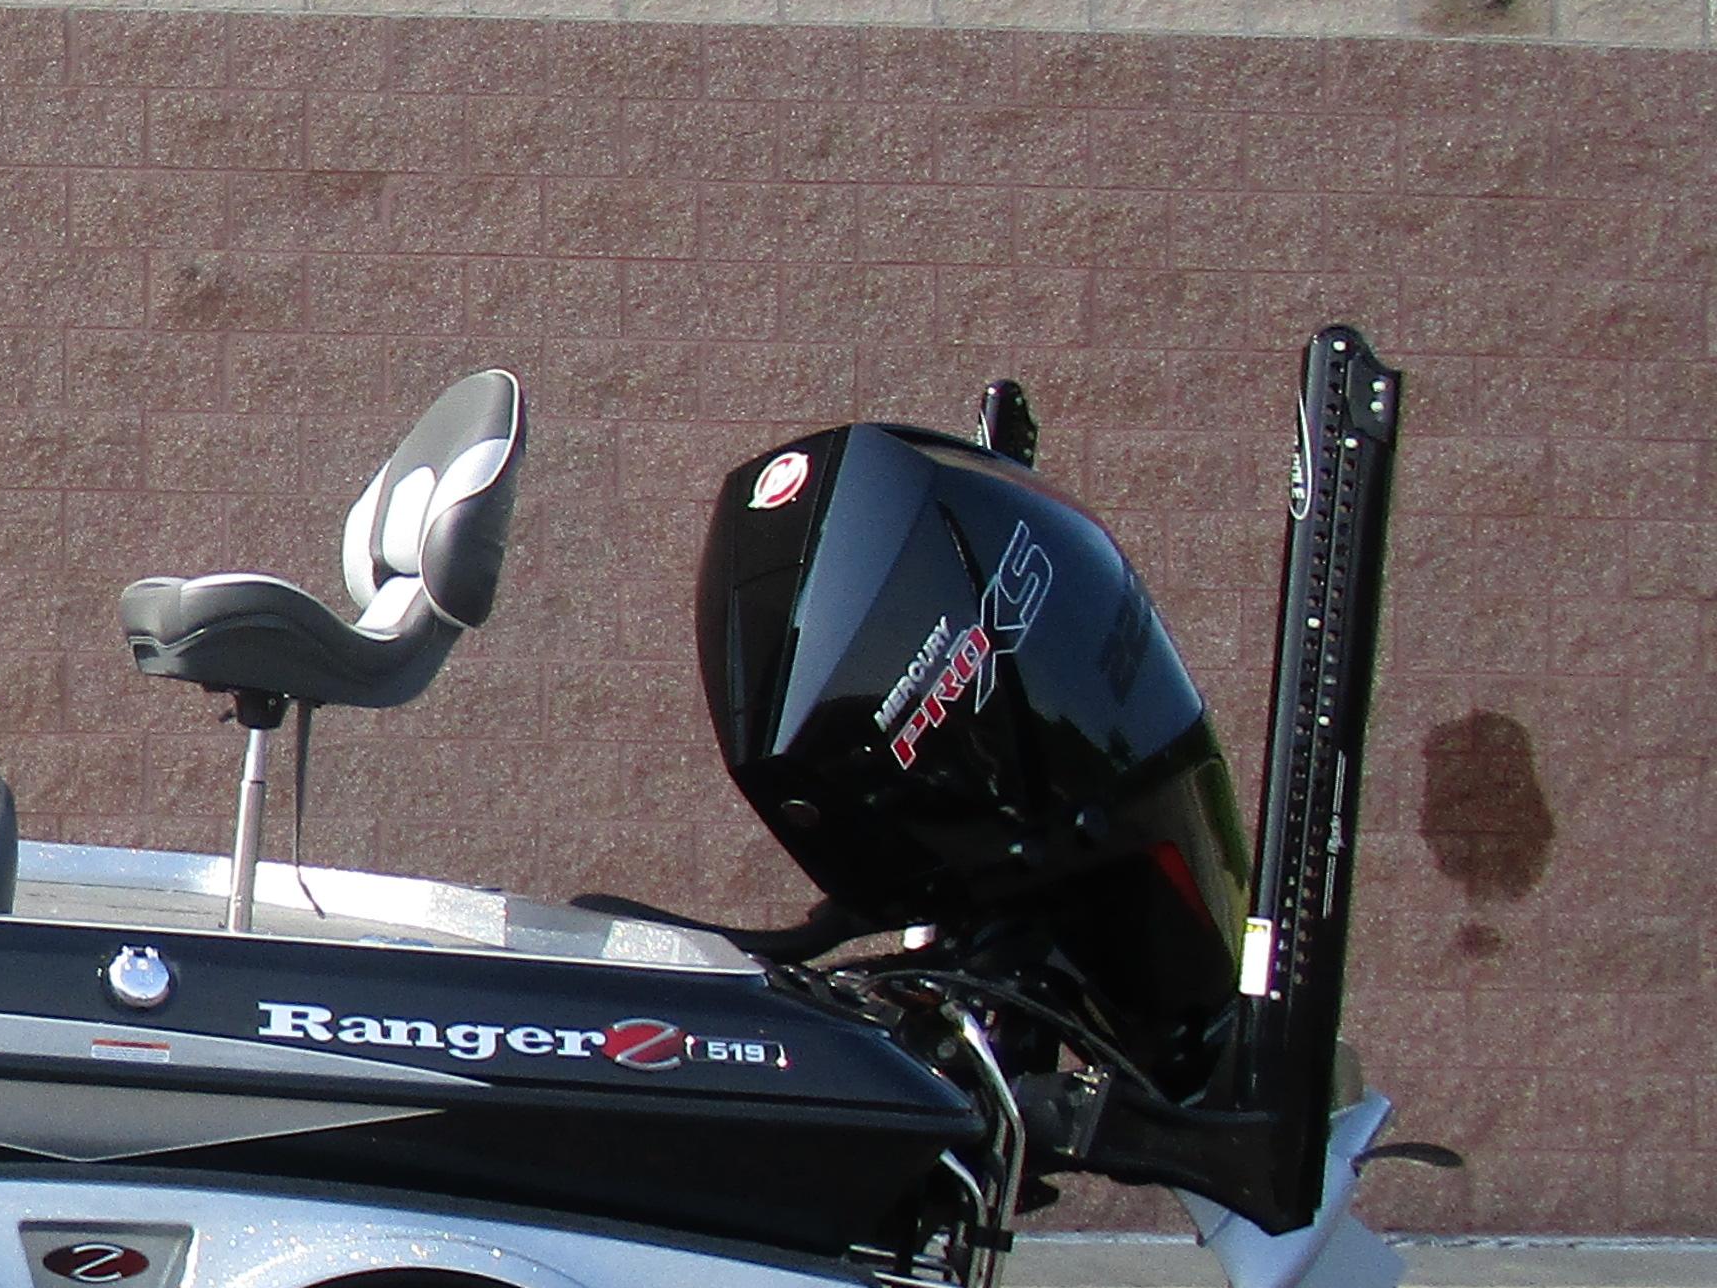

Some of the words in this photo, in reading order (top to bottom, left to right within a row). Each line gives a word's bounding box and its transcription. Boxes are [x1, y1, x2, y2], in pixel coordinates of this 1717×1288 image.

[872, 614, 953, 734] MERCURY
[890, 623, 990, 771] PRO
[974, 519, 1054, 715] XS
[257, 1001, 607, 1060] Ranger
[706, 1041, 767, 1064] 519
